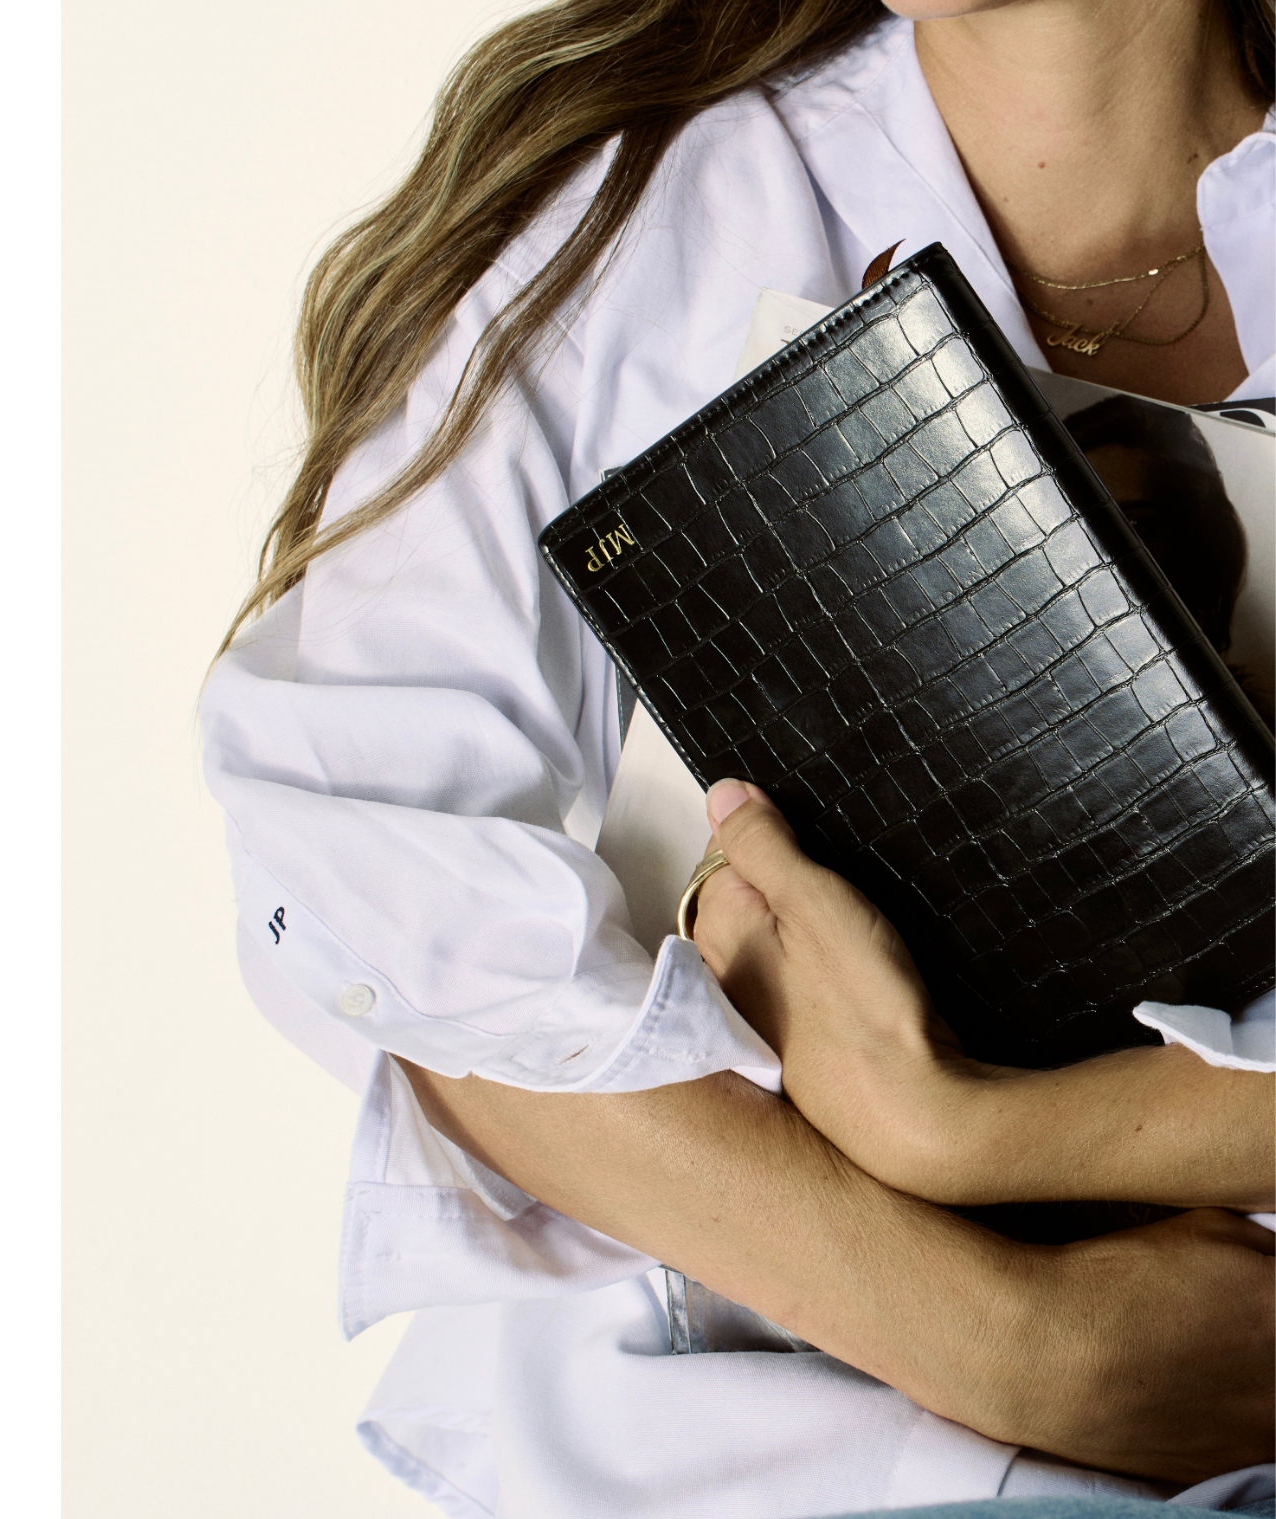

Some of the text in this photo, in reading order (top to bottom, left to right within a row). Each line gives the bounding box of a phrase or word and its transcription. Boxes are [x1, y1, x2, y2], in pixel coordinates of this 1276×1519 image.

[784, 325, 803, 337] SE
[585, 523, 635, 572] MJP
[268, 906, 287, 945] JP
